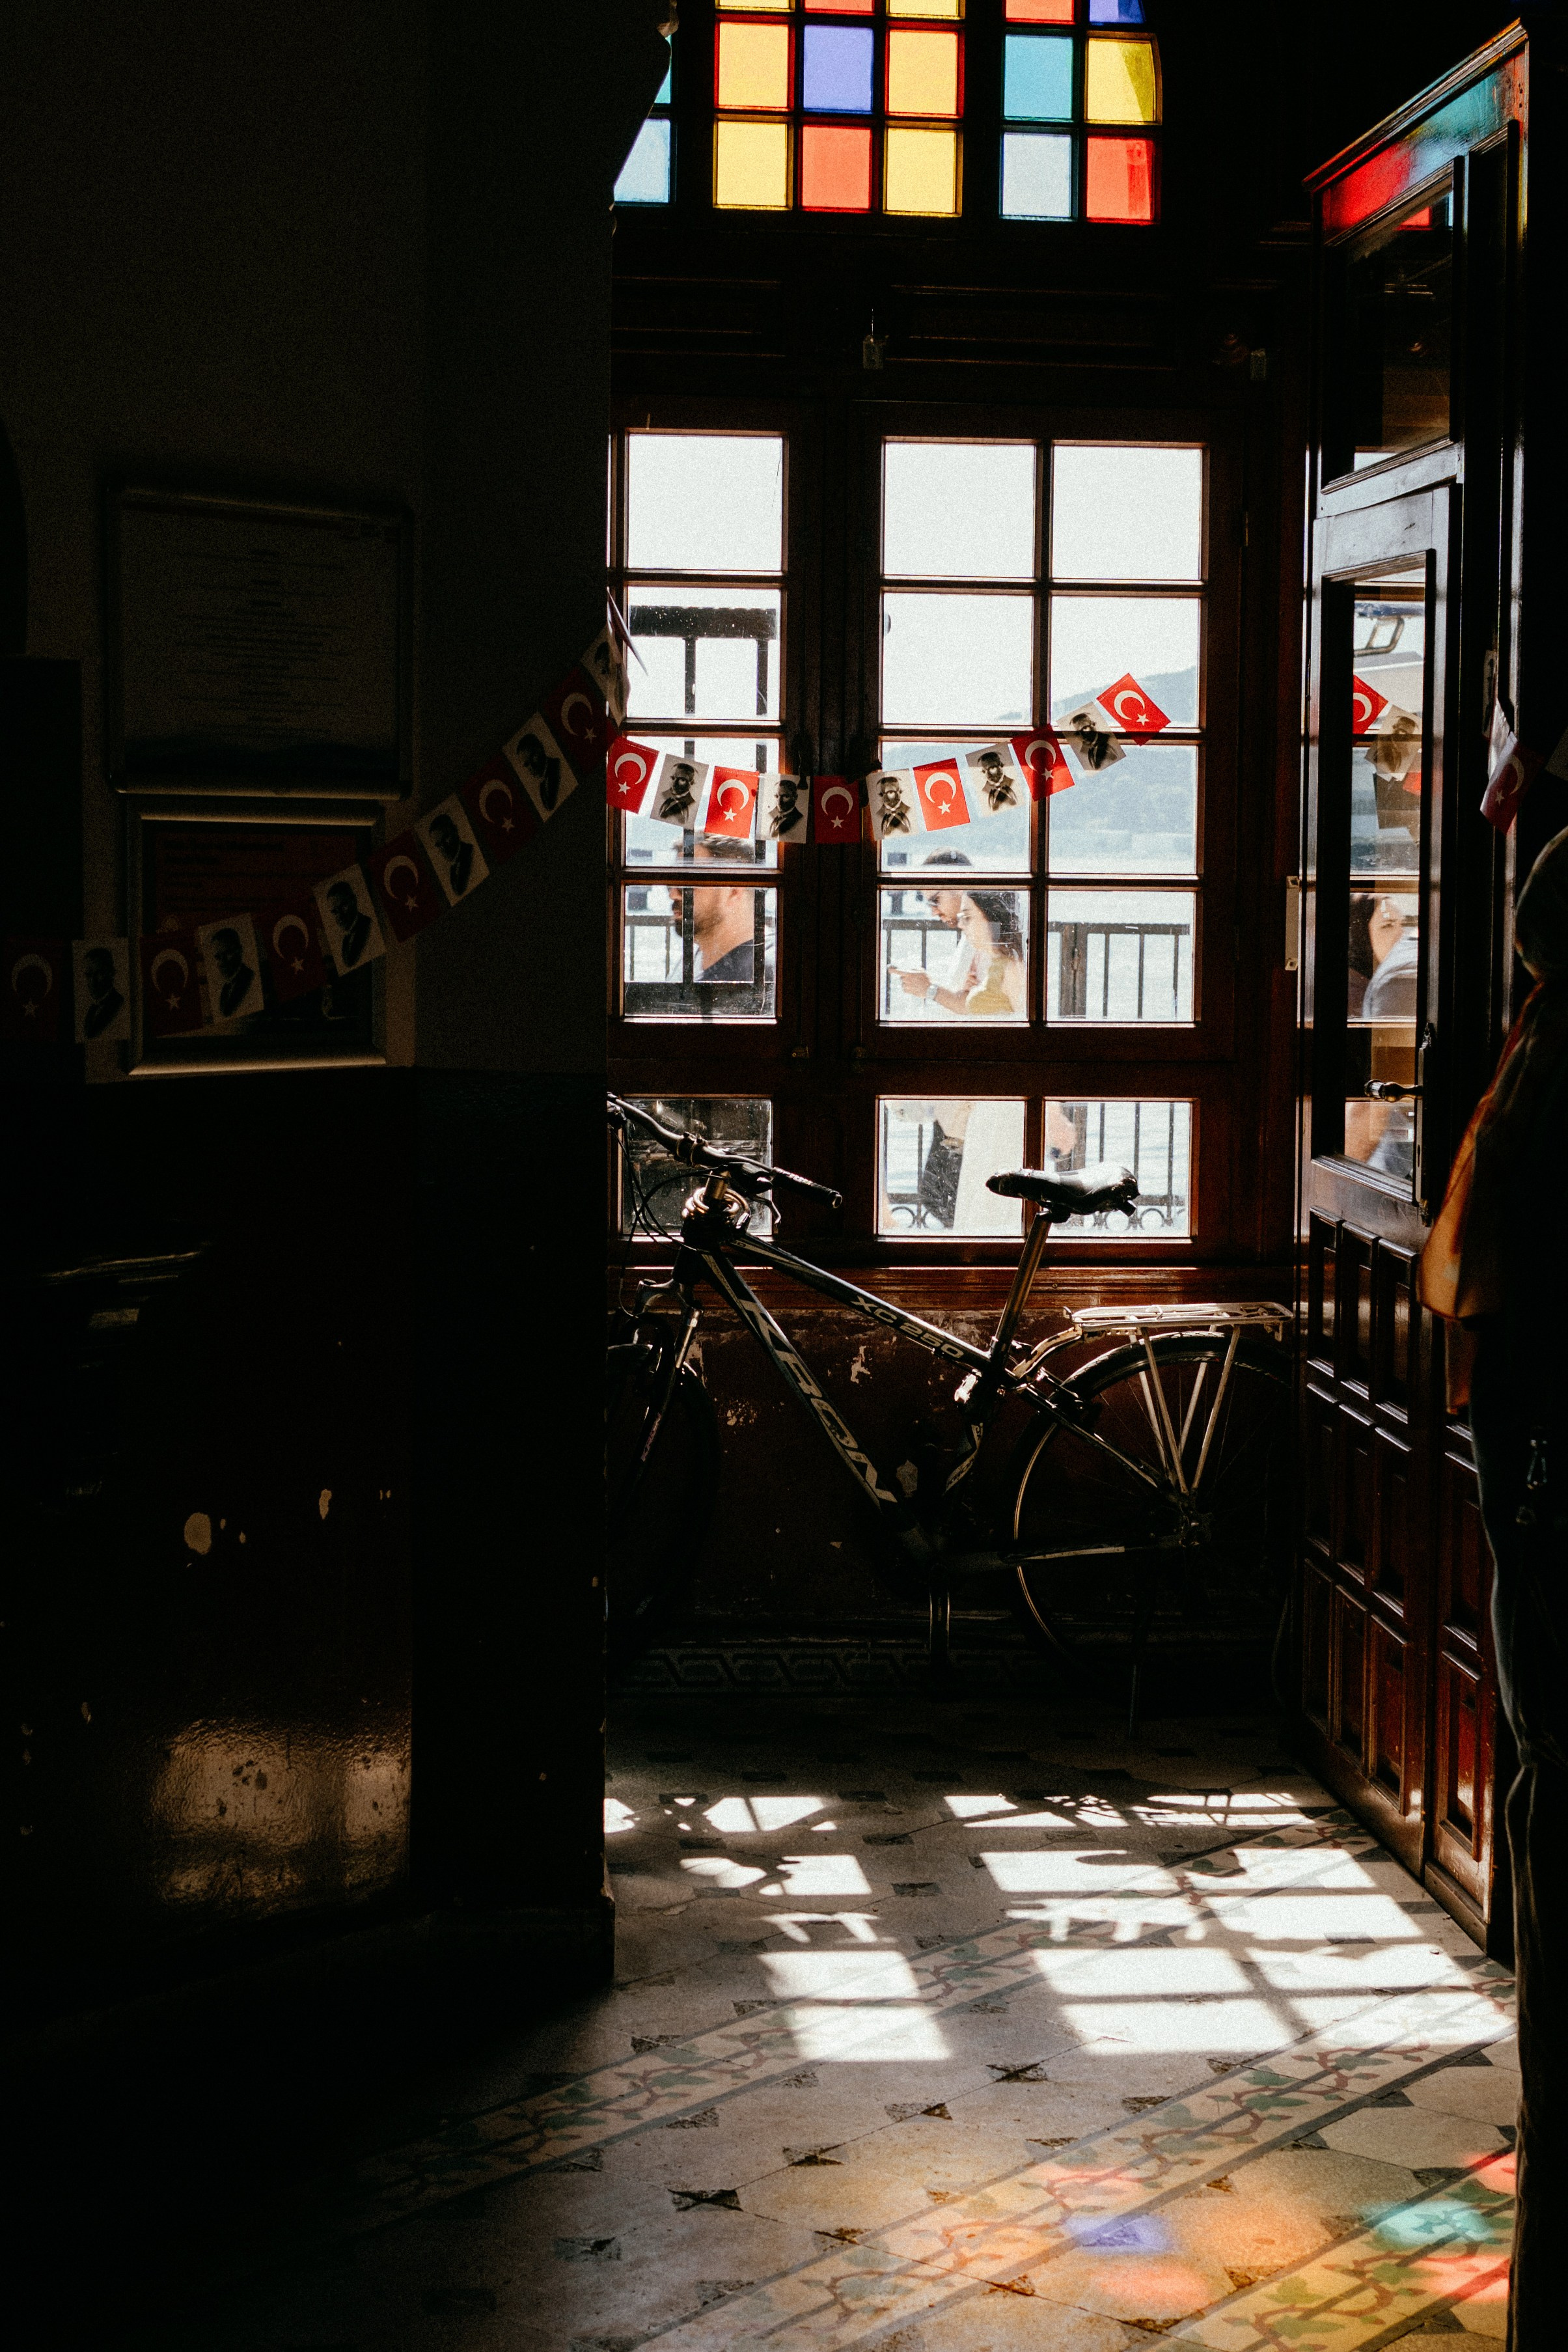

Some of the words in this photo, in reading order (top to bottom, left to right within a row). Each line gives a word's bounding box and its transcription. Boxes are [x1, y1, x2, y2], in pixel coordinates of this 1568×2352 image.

[851, 1296, 898, 1323] XC
[900, 1322, 965, 1359] 250
[738, 1299, 898, 1503] KRON
